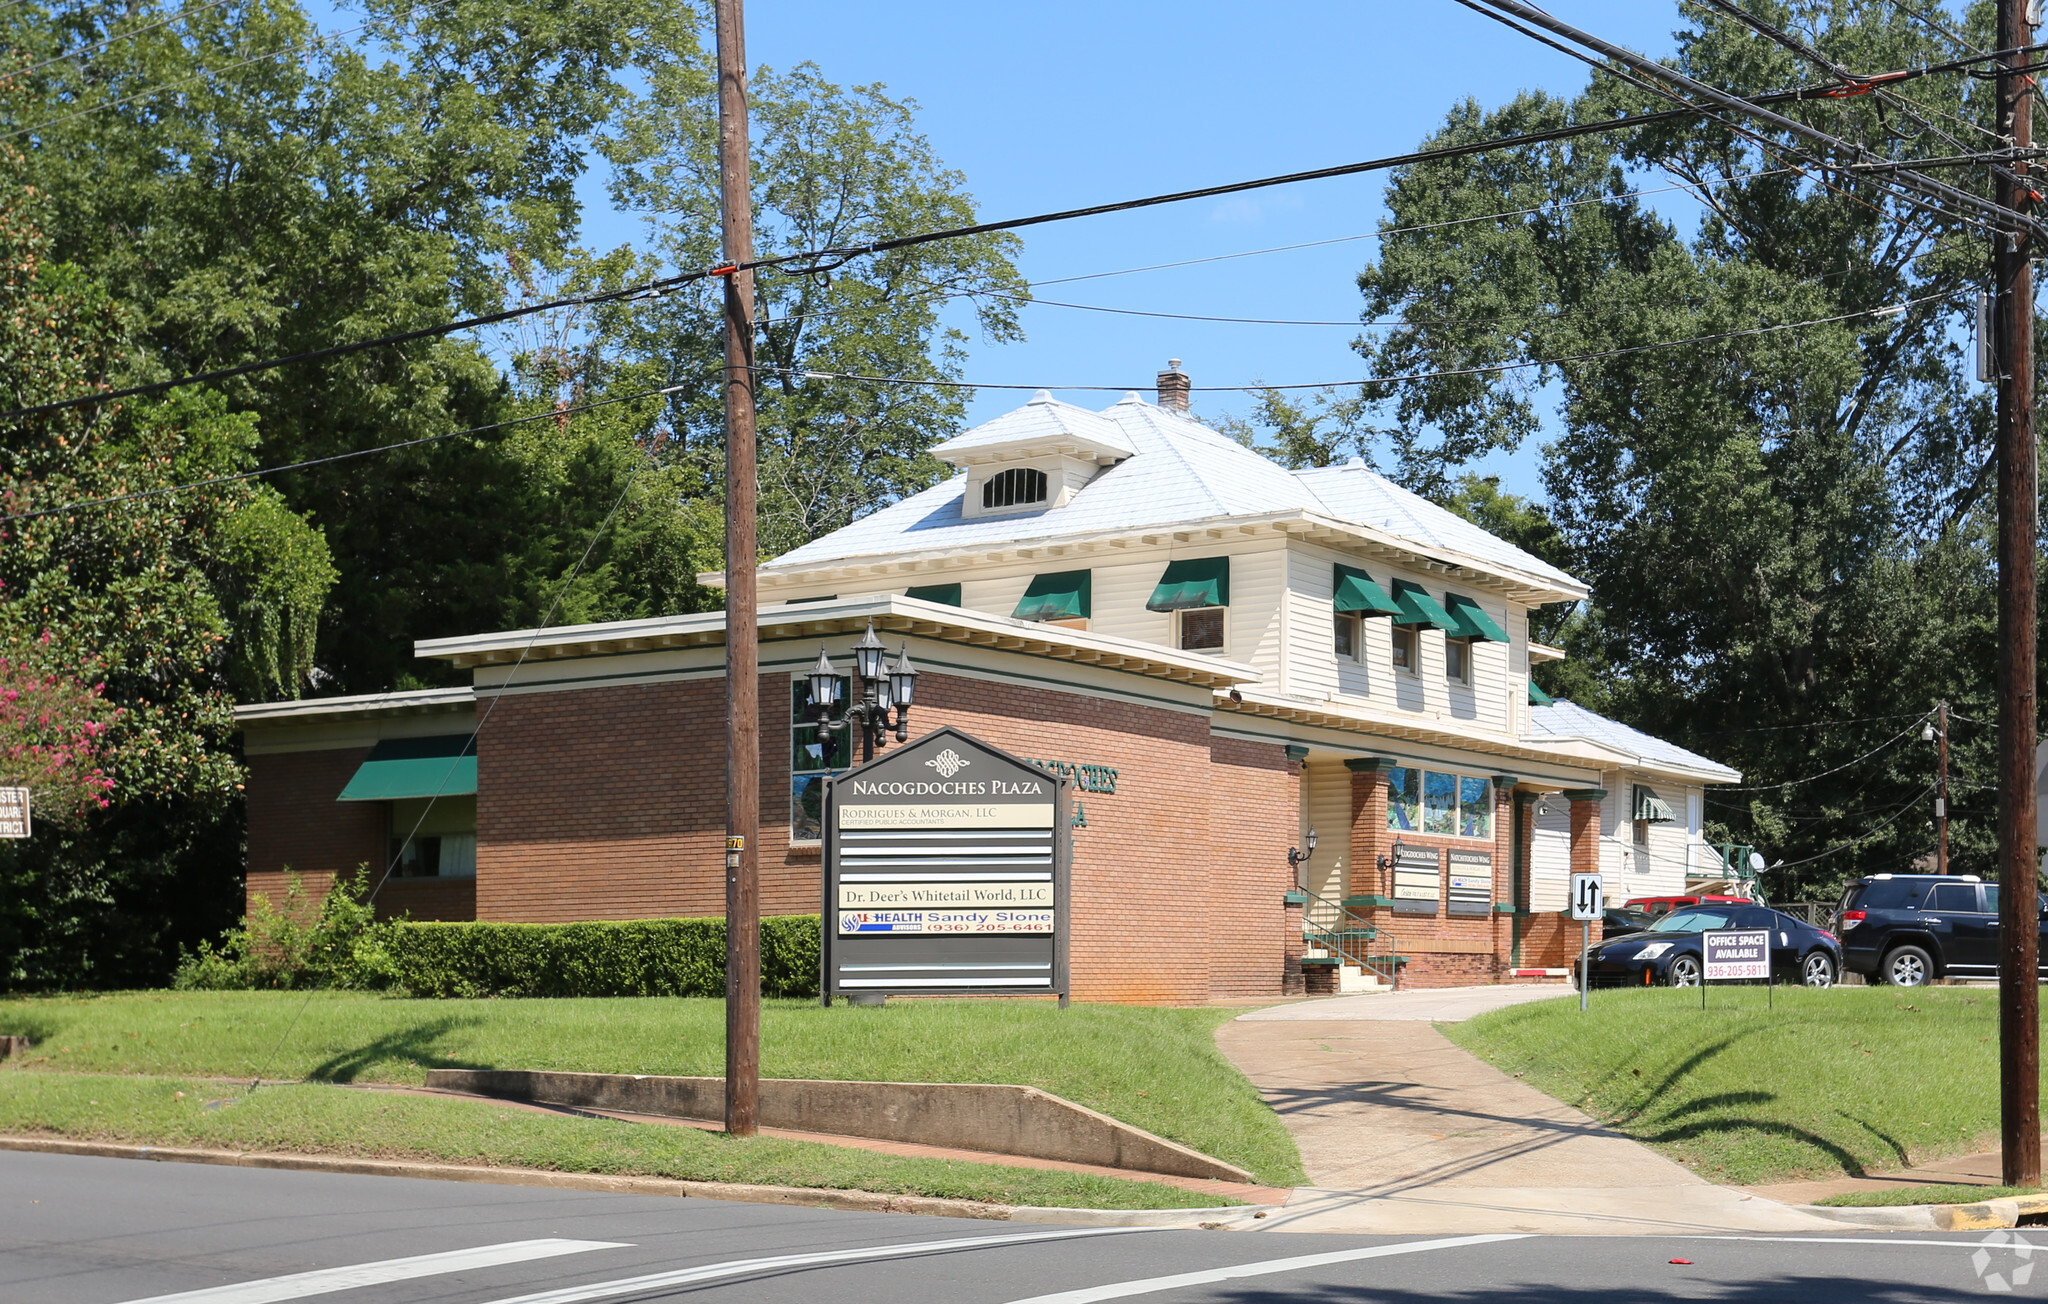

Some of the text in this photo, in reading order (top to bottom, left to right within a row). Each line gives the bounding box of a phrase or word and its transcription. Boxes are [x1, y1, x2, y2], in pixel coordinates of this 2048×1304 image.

[852, 780, 1042, 795] NACOGDOCHES PLAZA
[0, 791, 24, 803] STER
[842, 808, 905, 818] RODRIGUES
[908, 808, 917, 818] &
[976, 808, 997, 818] LLC
[846, 888, 1047, 903] Dr. Deer's Whitetail World, LLC
[928, 912, 989, 924] Sandy
[996, 912, 1051, 922] Slone
[927, 923, 970, 932] (936)
[976, 923, 1052, 931] 205-6461
[1709, 935, 1763, 946] OFFICE SPACE
[1715, 948, 1757, 958] AVAILABLE
[1708, 965, 1766, 976] 936-205-5811
